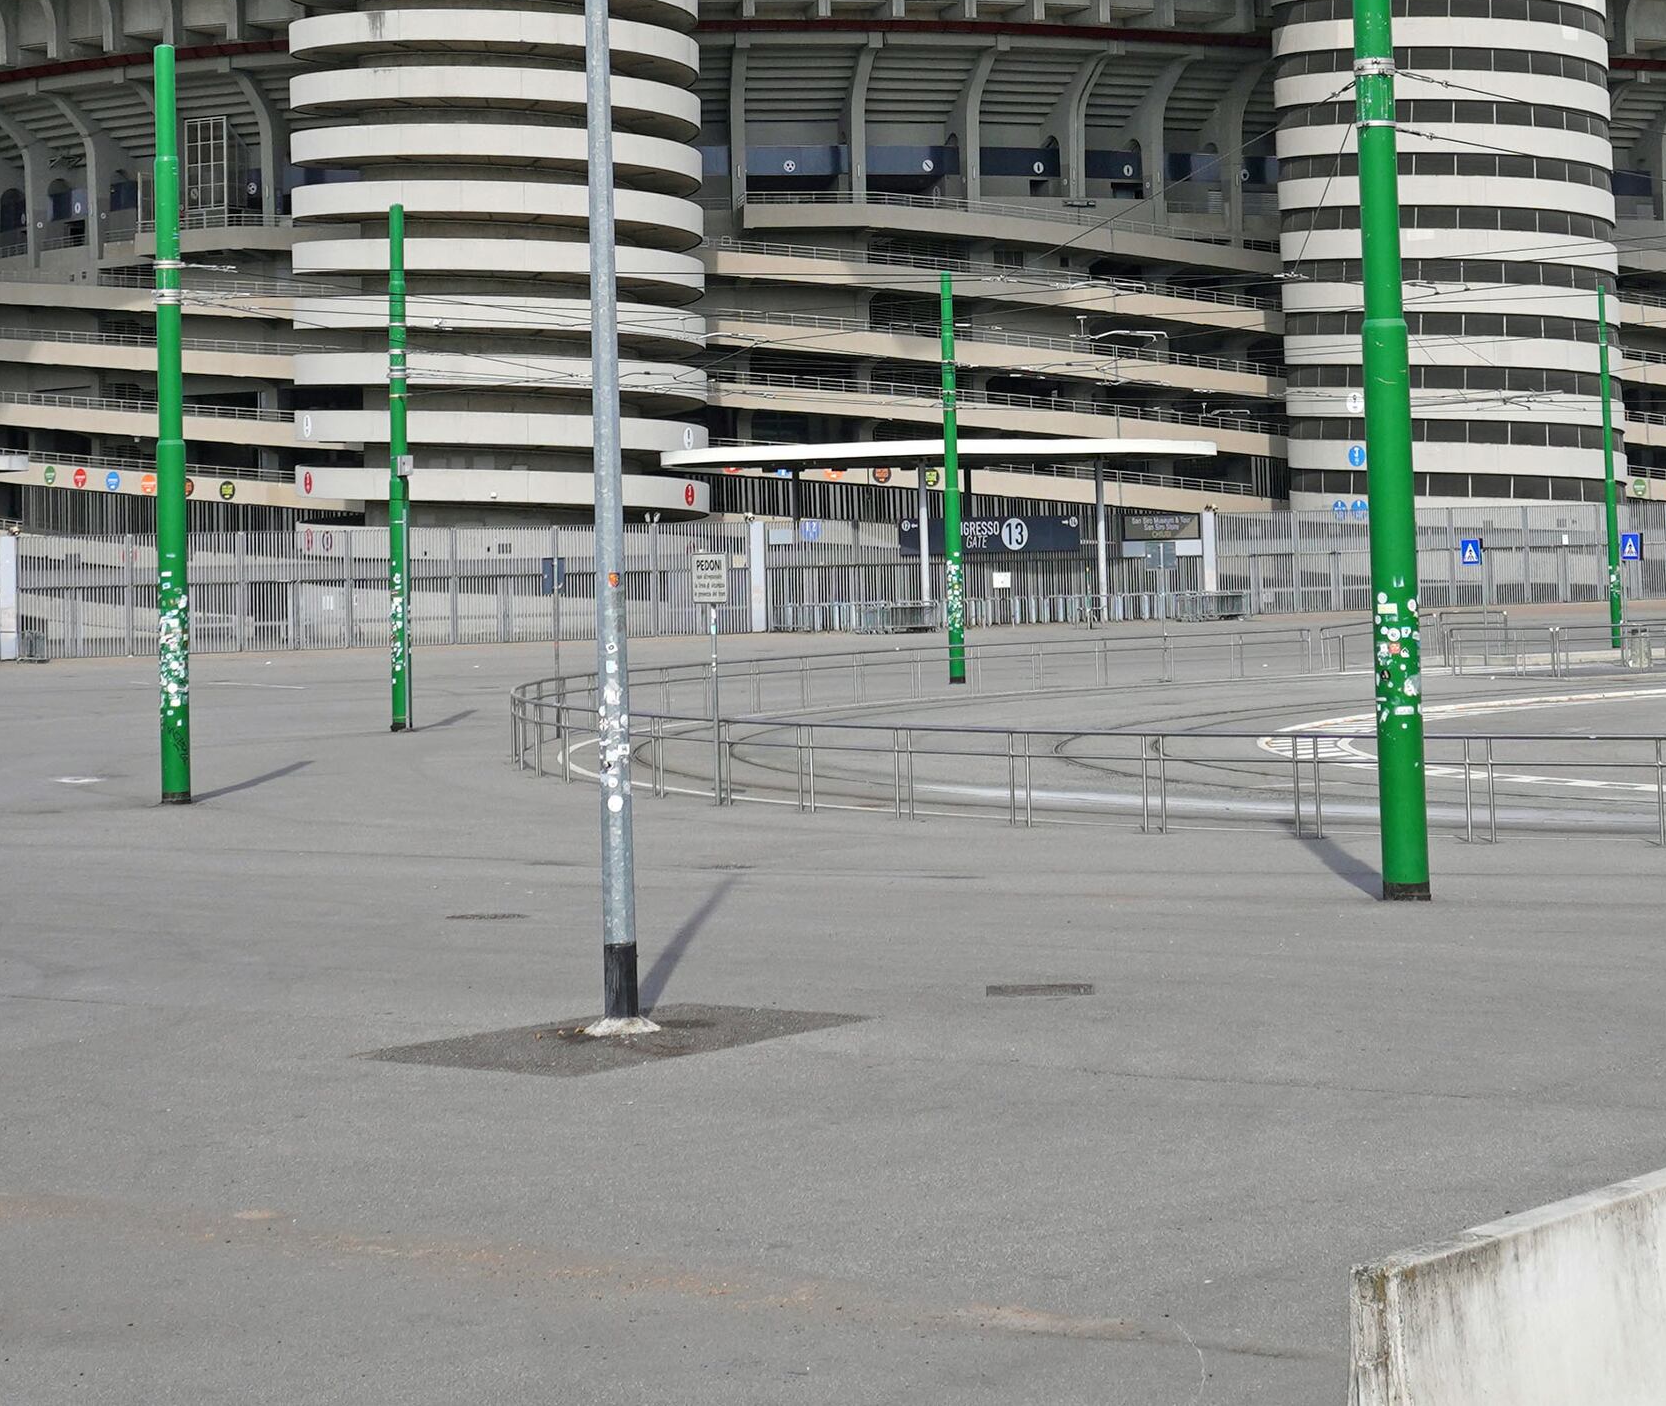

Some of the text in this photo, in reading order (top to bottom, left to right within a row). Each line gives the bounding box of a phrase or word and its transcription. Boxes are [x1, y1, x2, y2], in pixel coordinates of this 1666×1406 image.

[1005, 522, 1023, 546] 13
[966, 535, 988, 549] GATE
[696, 559, 722, 571] PEDONI
